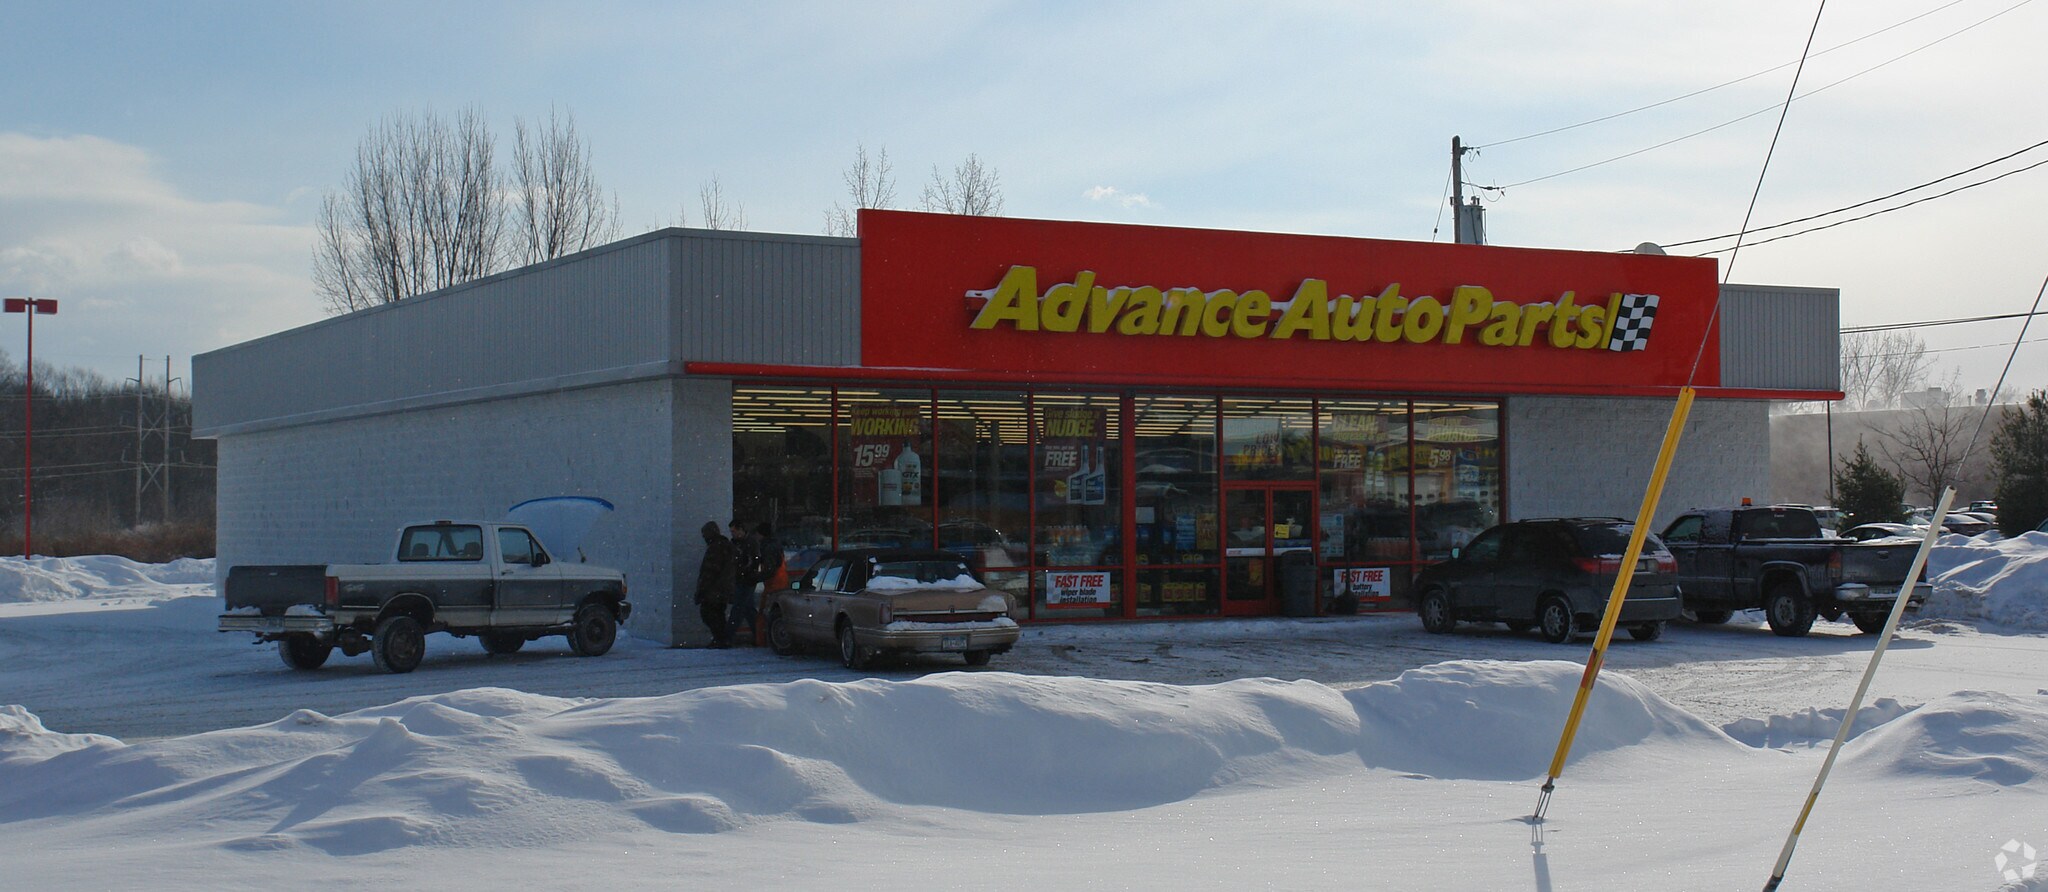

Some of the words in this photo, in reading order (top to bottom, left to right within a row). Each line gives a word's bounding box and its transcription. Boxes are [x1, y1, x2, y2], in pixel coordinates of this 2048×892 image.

[970, 265, 1271, 339] Advance
[1269, 278, 1443, 344] Auto
[1442, 285, 1608, 349] Parts
[871, 408, 901, 417] working
[1045, 451, 1078, 467] FREE
[1333, 454, 1362, 469] FREE
[902, 471, 920, 479] GTX
[1055, 575, 1079, 588] FAST
[1080, 575, 1104, 588] FREE
[1341, 570, 1361, 583] FST
[1363, 570, 1383, 582] FREE
[1080, 588, 1096, 596] blade
[1352, 584, 1372, 592] battery
[1060, 596, 1097, 604] installation
